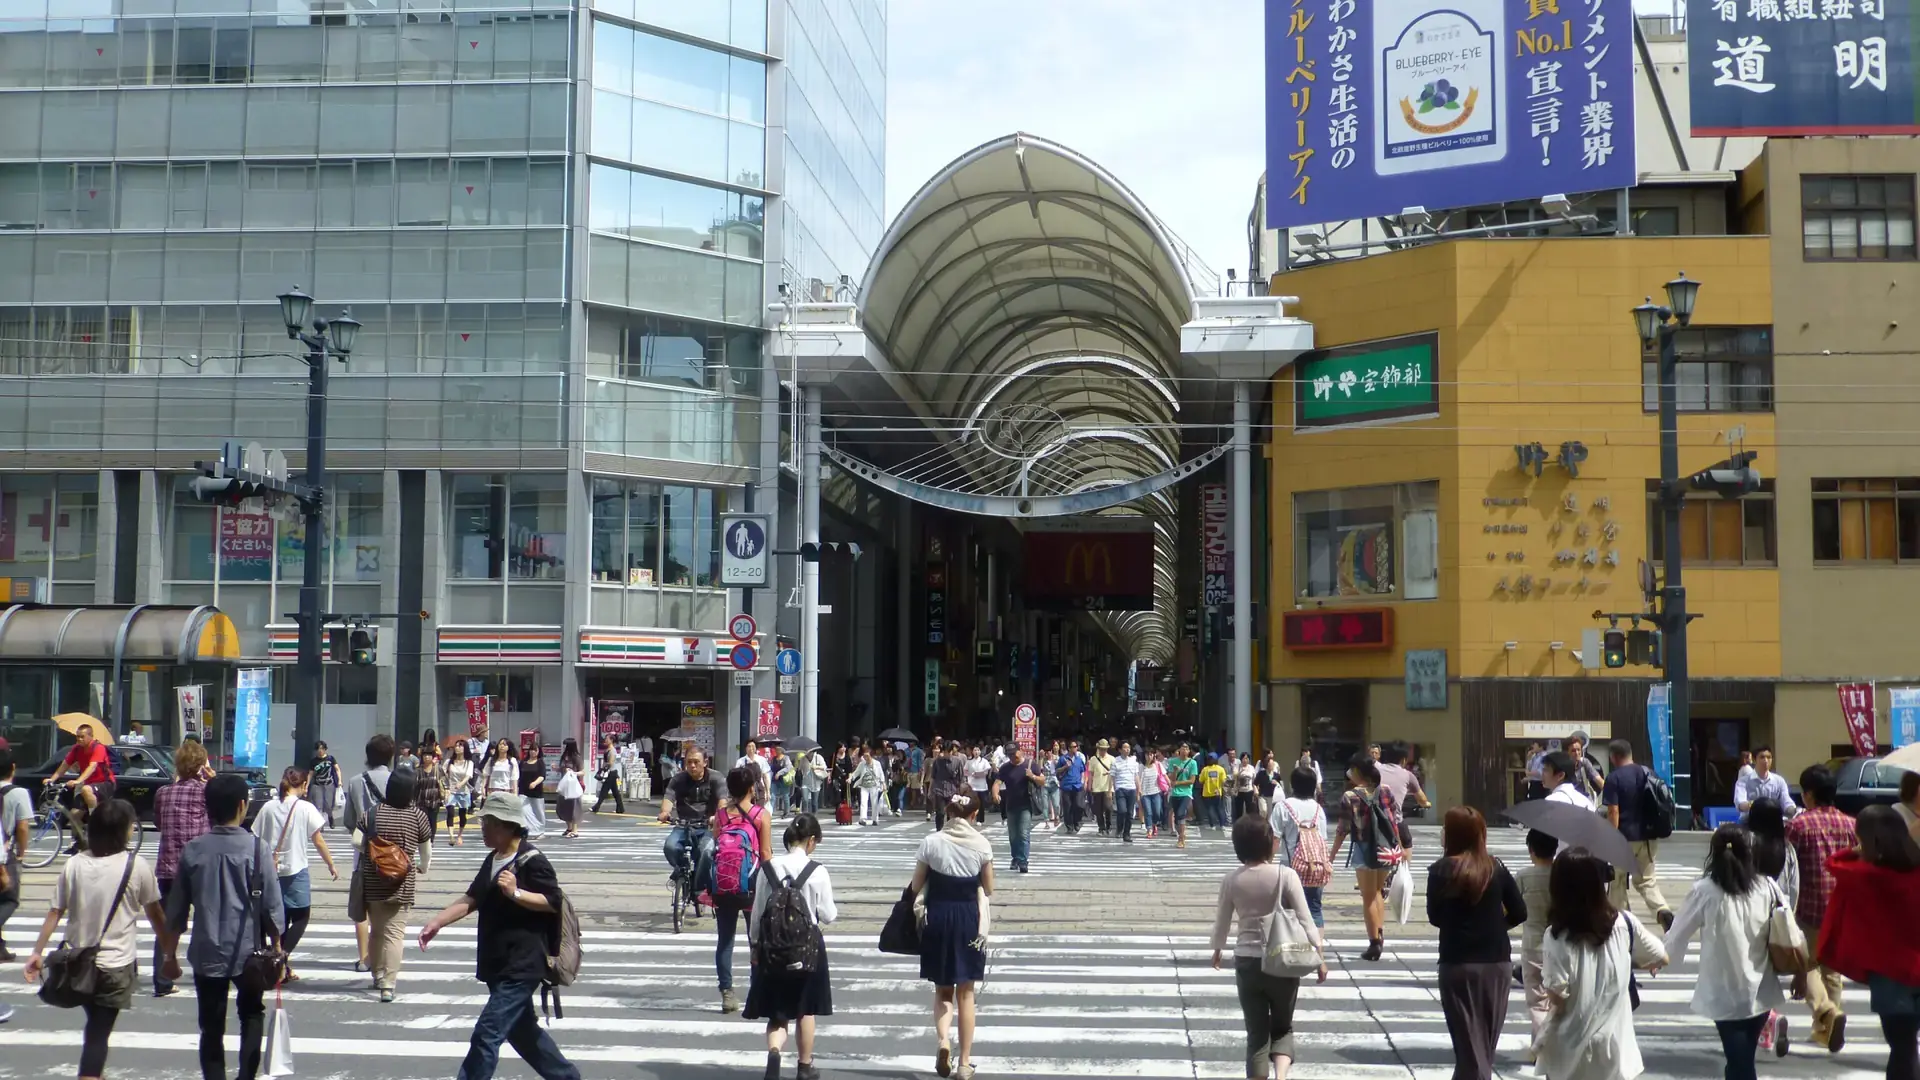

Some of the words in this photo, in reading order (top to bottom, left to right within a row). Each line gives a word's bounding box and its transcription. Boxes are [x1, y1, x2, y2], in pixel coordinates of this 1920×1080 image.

[1411, 63, 1466, 79] ブルーベリーアイ
[1328, 0, 1358, 170] わかさ生活の
[1285, 0, 1316, 205] ルーベリーアイ
[222, 518, 270, 535] ご協力
[727, 567, 762, 577] 12-20
[1206, 574, 1226, 589] 24
[735, 622, 751, 634] 20
